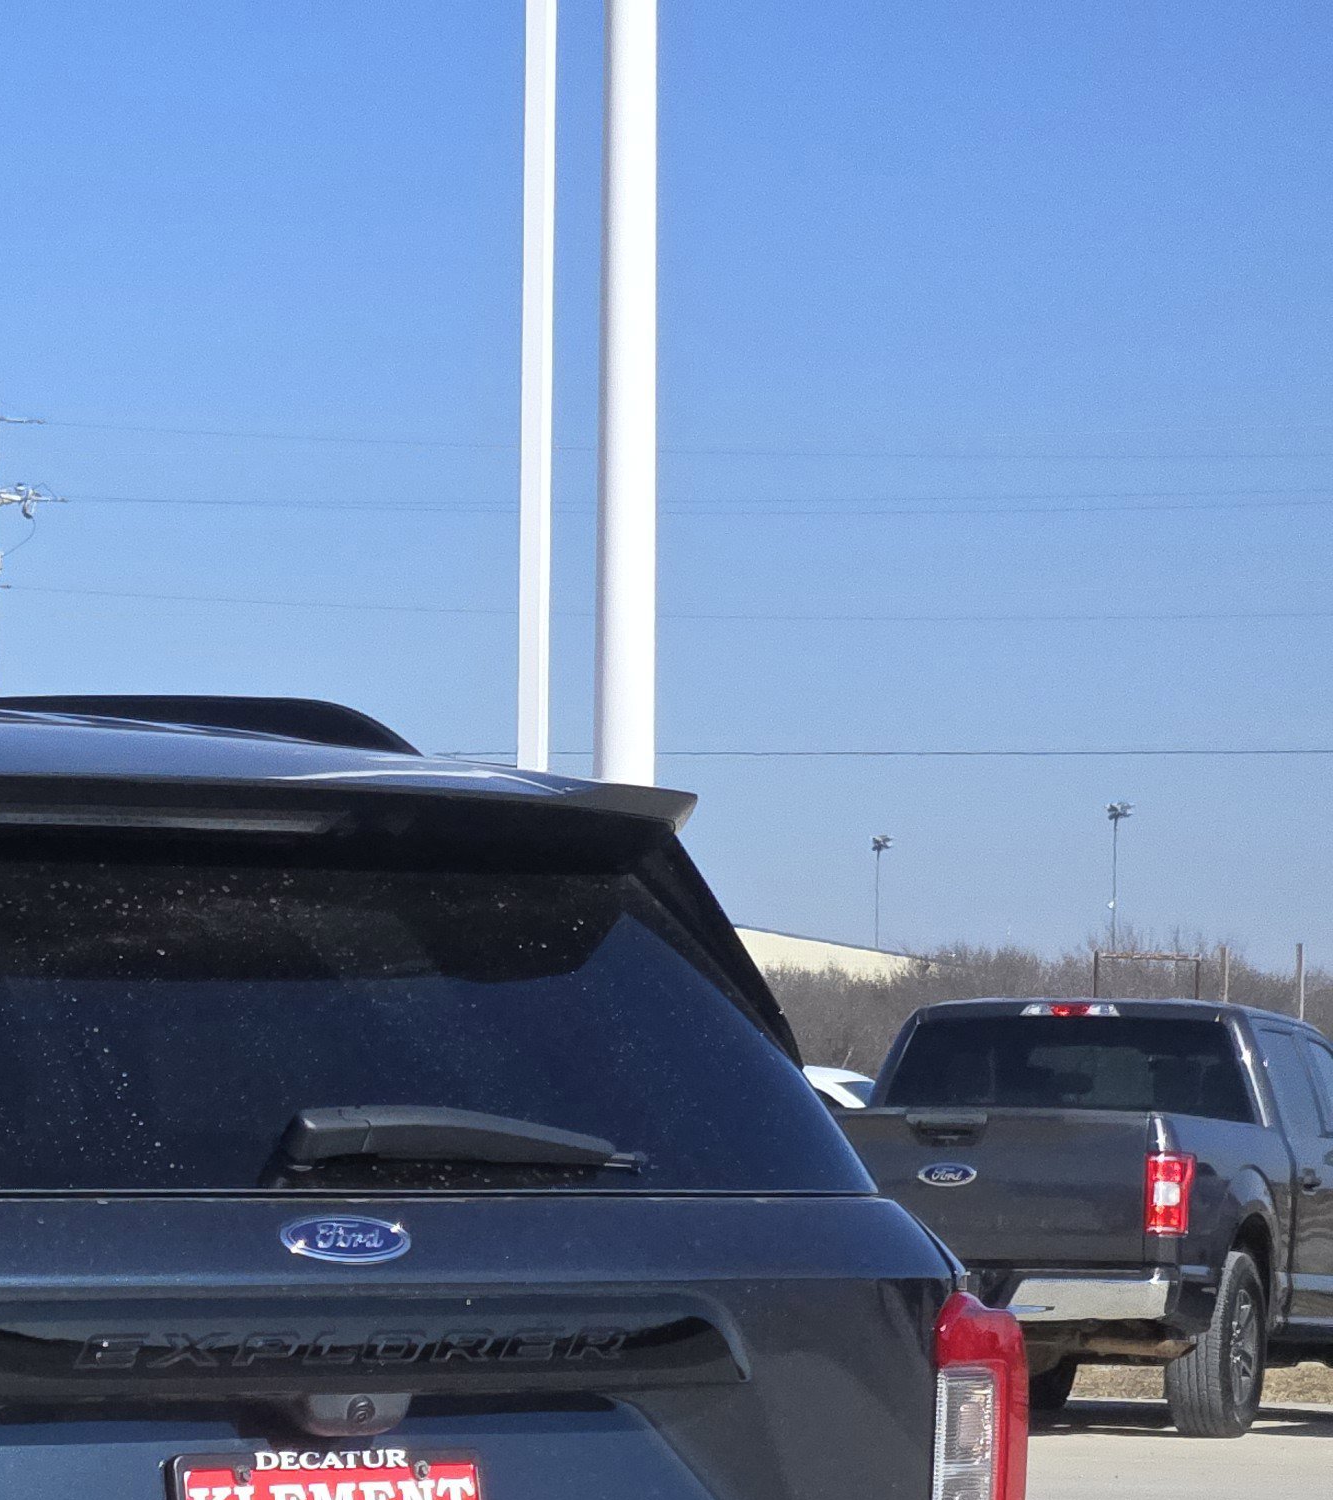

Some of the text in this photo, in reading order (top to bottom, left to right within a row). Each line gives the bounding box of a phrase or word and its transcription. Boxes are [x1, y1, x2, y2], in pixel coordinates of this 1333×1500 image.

[932, 1167, 963, 1181] Ford
[315, 1222, 384, 1248] Ford
[74, 1326, 631, 1369] EXPLORER
[254, 1449, 409, 1471] DECATUR
